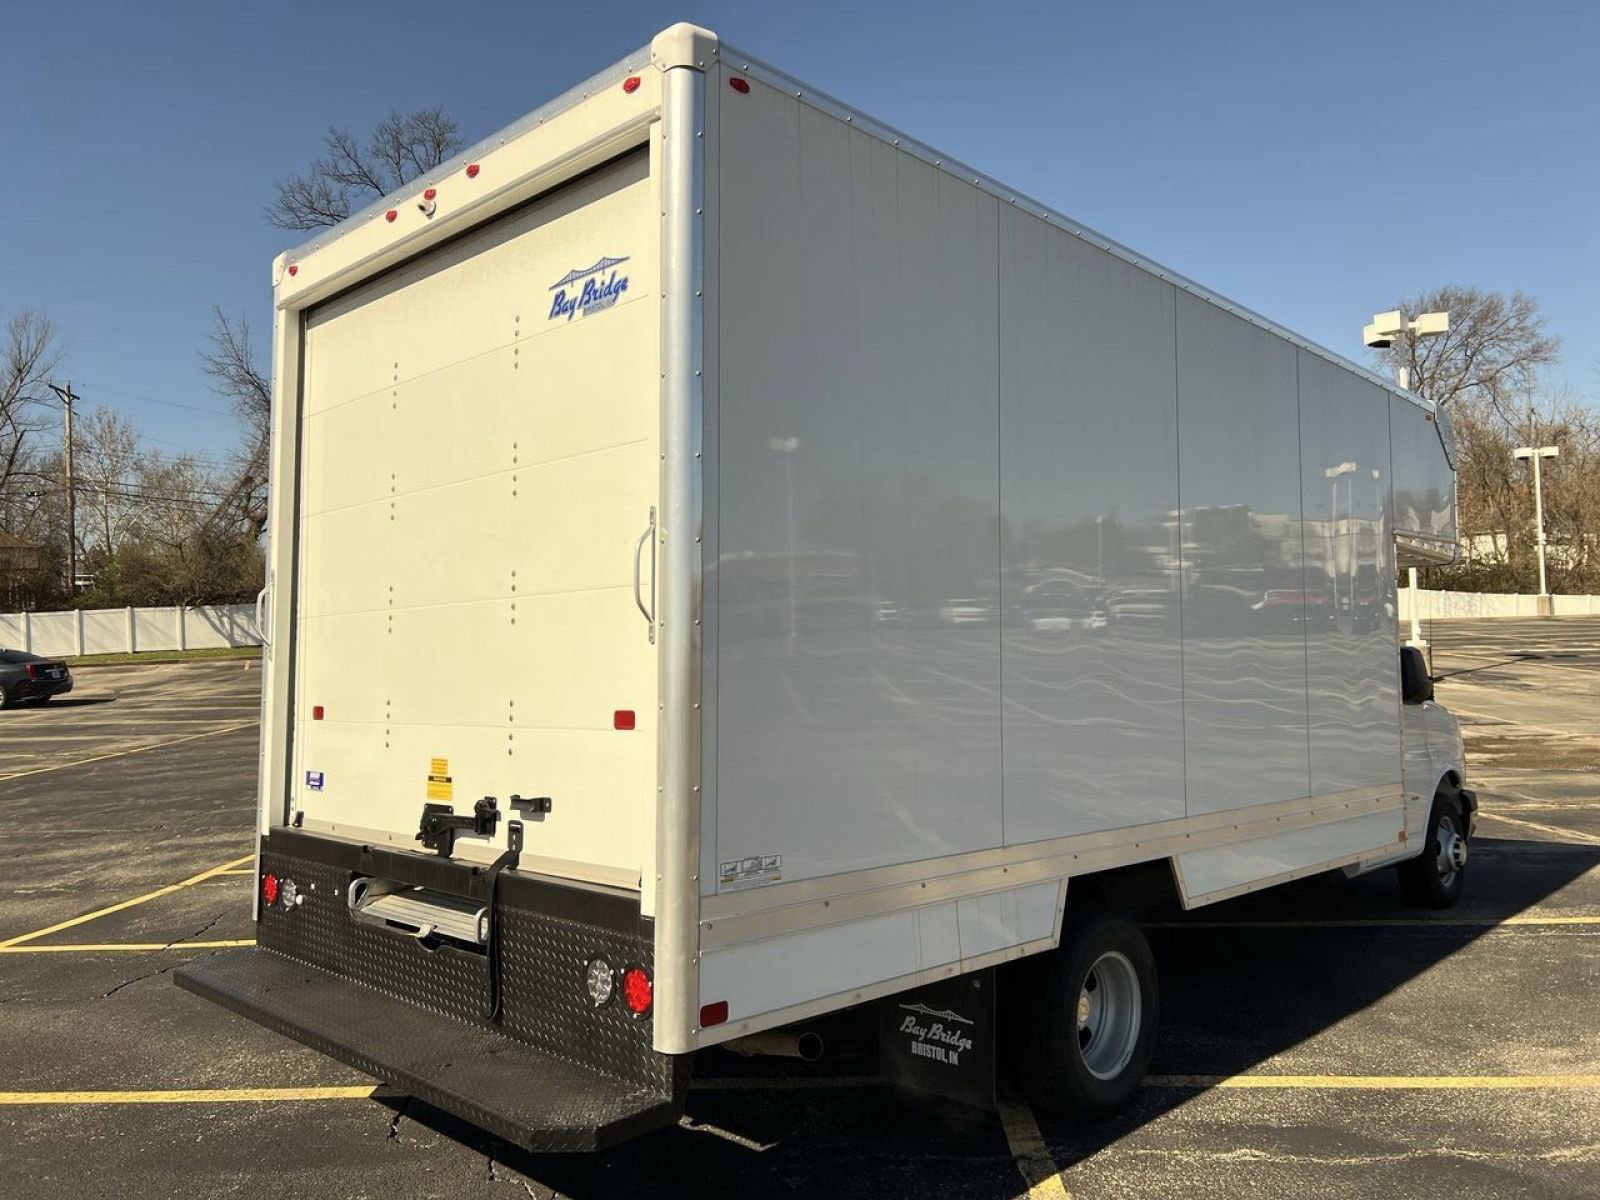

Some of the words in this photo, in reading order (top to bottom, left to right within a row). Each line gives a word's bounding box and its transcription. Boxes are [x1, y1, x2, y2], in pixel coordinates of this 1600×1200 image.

[548, 289, 578, 321] Bay
[577, 270, 628, 308] Bridge
[900, 1015, 927, 1041] Bay
[927, 1023, 972, 1052] Bridge
[949, 1050, 959, 1066] IN
